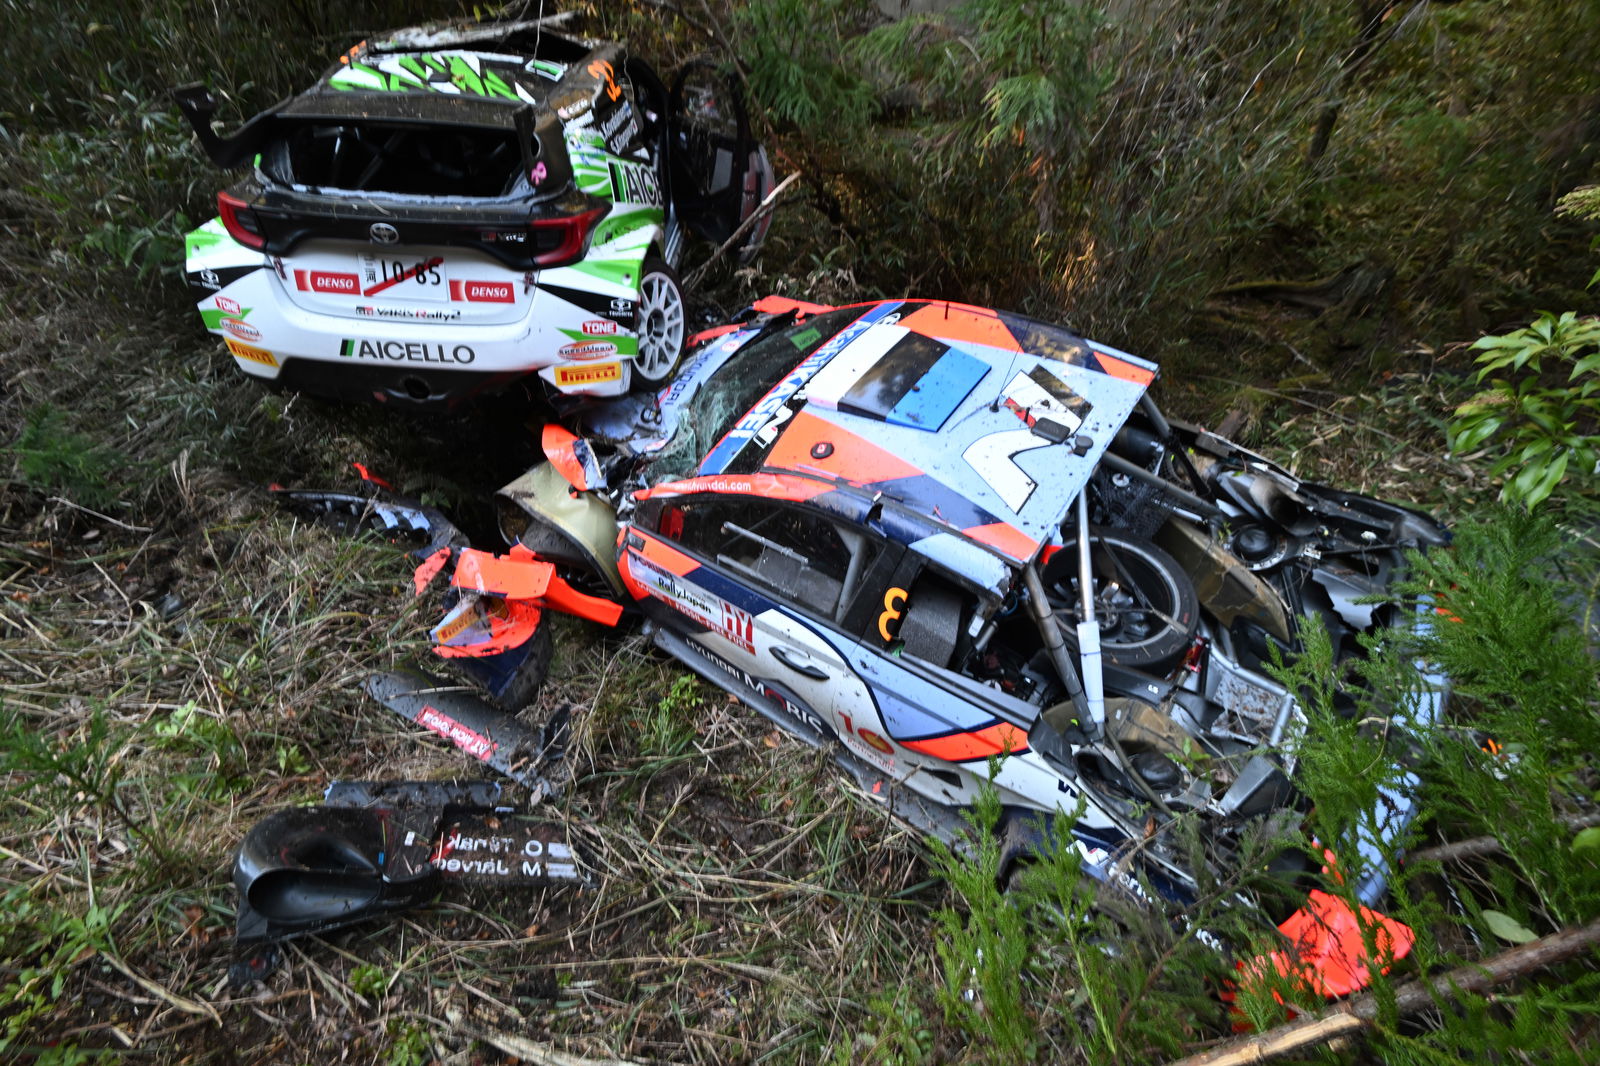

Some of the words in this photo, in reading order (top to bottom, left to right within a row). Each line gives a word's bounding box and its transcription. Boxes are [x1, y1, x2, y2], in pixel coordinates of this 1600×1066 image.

[316, 276, 354, 290] DENSO
[471, 286, 508, 298] DENSO
[219, 298, 240, 314] TONE
[585, 322, 614, 333] TONE
[358, 340, 475, 364] AICELLO
[560, 365, 616, 382] PIRELLI
[686, 637, 740, 680] HYUNDAI
